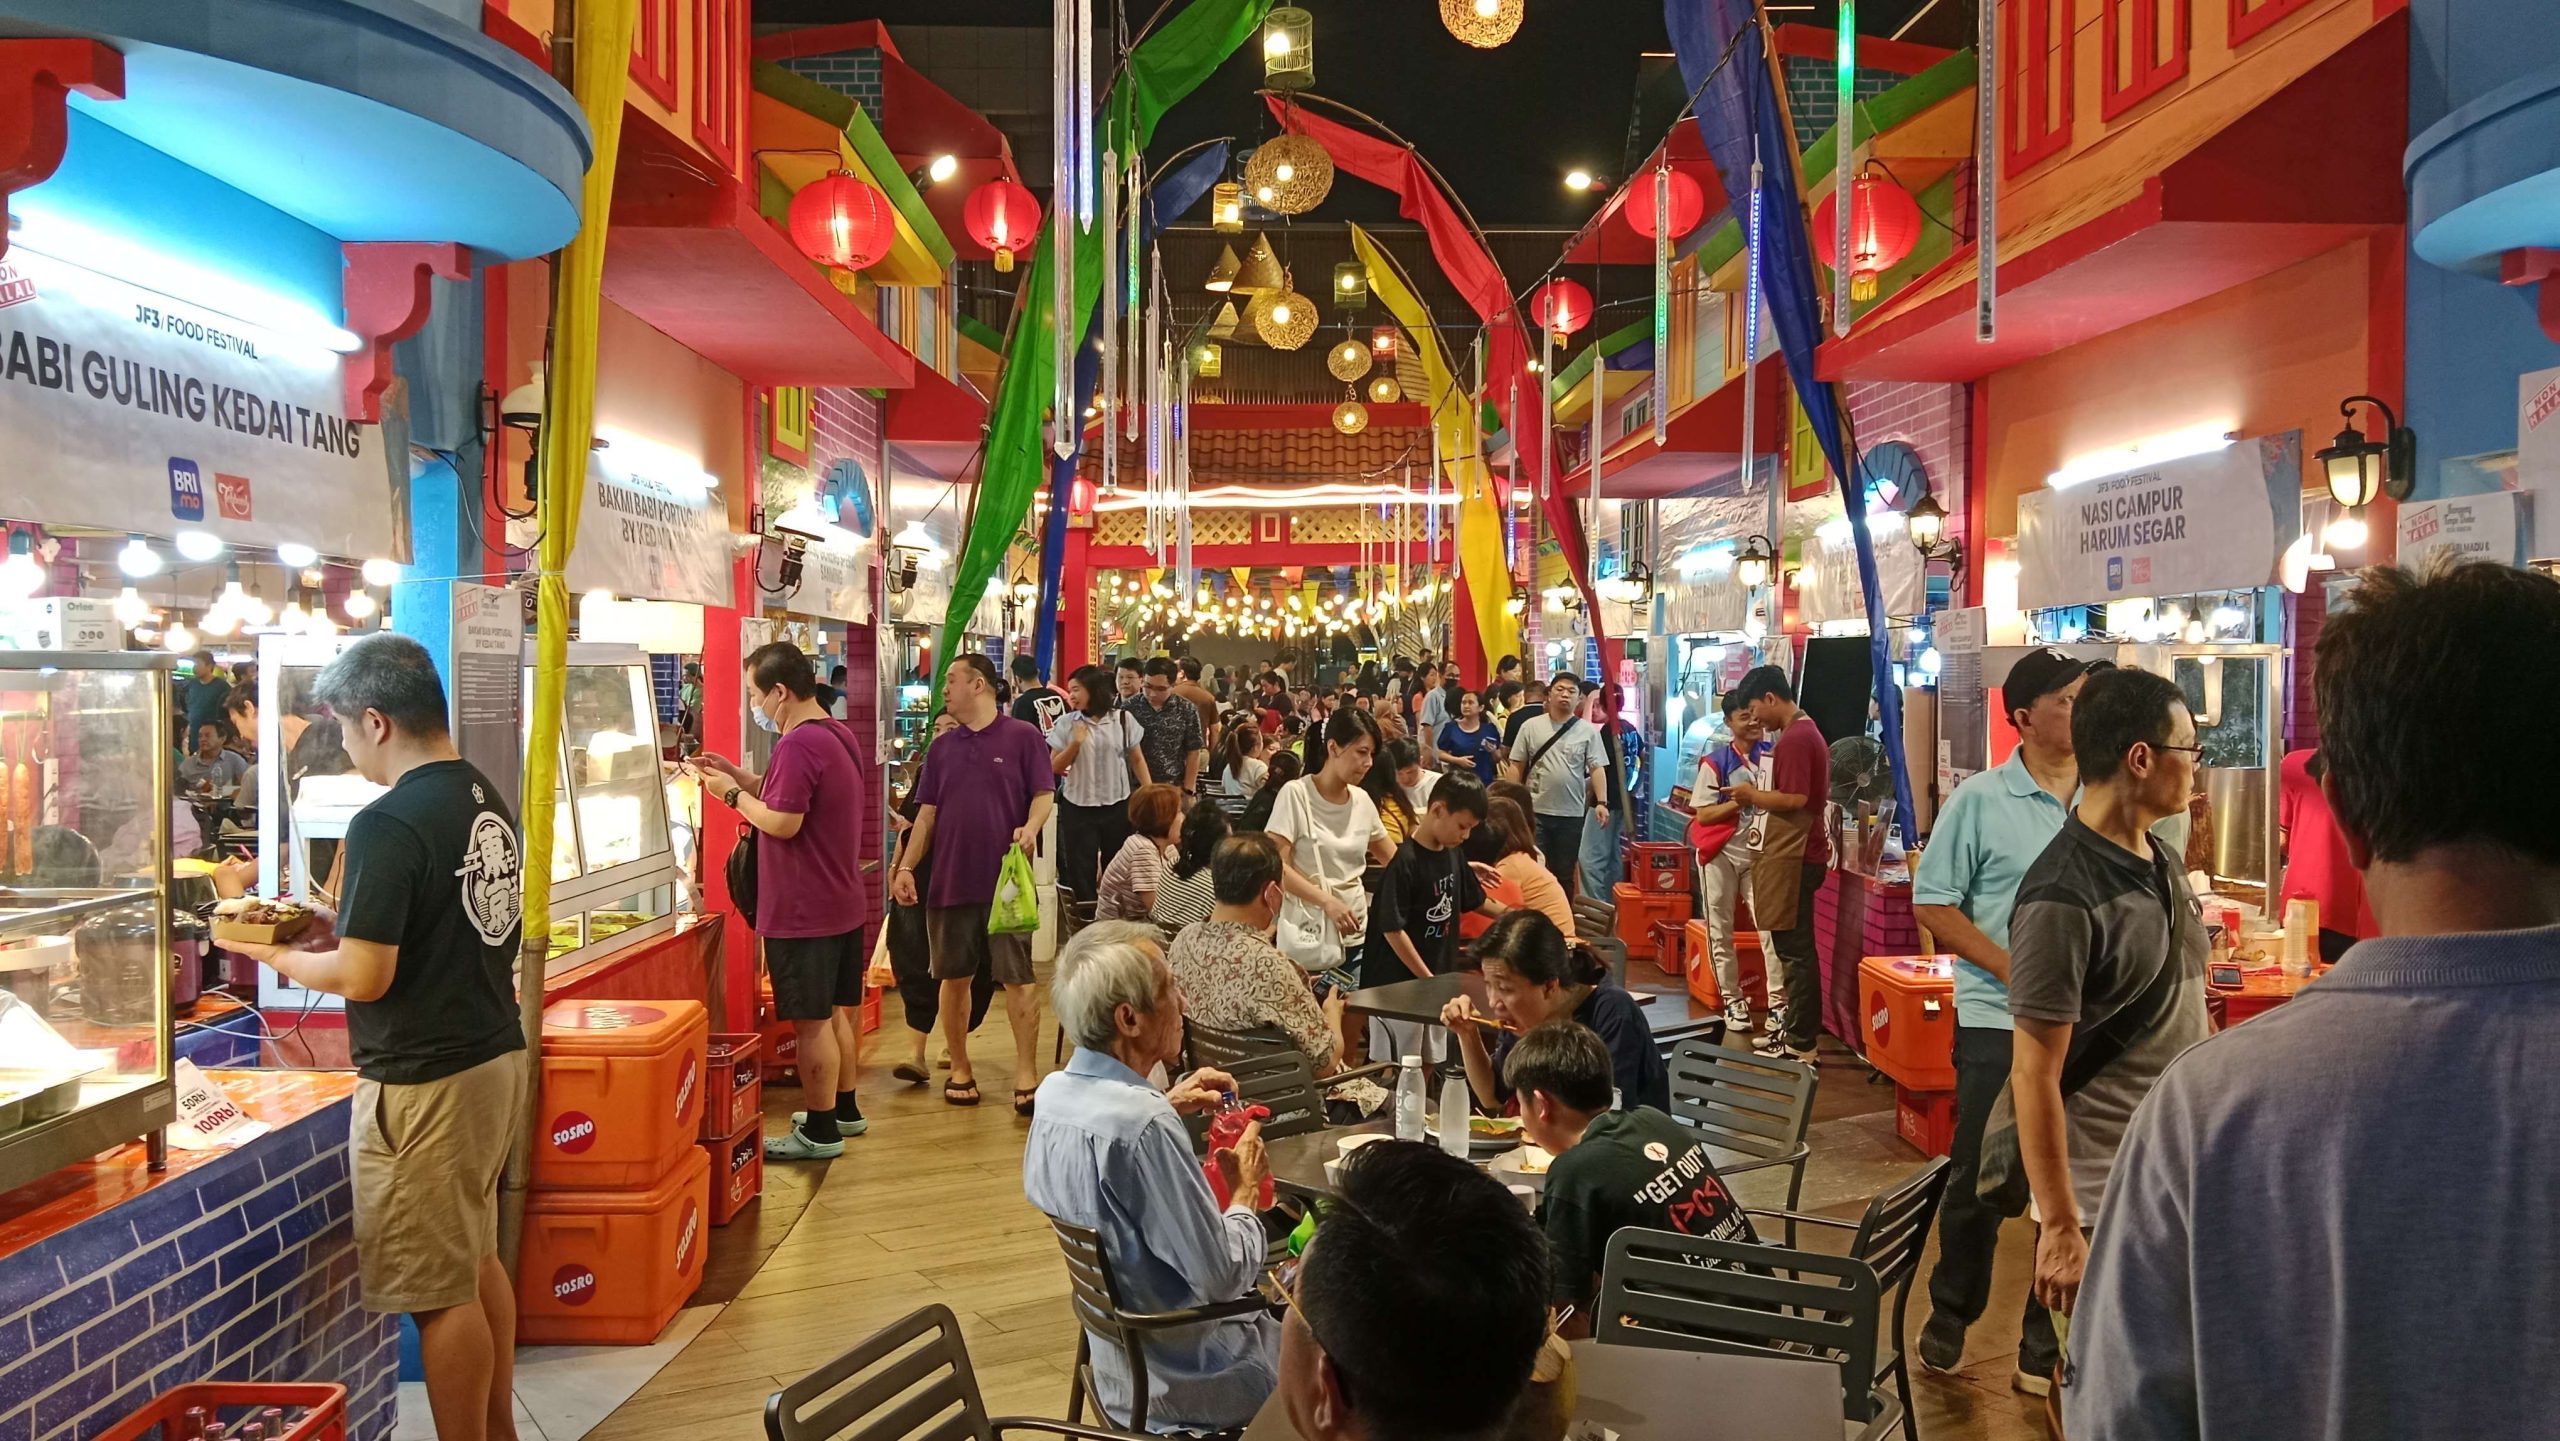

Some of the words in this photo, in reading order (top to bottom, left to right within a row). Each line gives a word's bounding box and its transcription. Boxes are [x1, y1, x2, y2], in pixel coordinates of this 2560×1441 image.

[0, 279, 35, 303] LAL
[167, 314, 204, 341] FOOD
[206, 327, 258, 360] FESTIVAL
[0, 330, 74, 394] ABI
[82, 350, 207, 422] GULING
[212, 383, 293, 444] KEDAI
[296, 406, 361, 459] TANG
[2534, 382, 2557, 409] NON
[173, 469, 198, 494] BRI
[2130, 470, 2162, 487] FESTIVAL
[598, 482, 634, 514] BAKMI
[634, 491, 657, 522] BABI
[2081, 499, 2113, 527] NASI
[2116, 485, 2183, 520] CAMPUR
[621, 517, 636, 544] BY
[2080, 523, 2130, 555] HARUM
[2133, 514, 2186, 546] SEGAR
[1872, 1007, 1889, 1032] SOSRO
[776, 1039, 797, 1055] SOSR
[182, 1089, 209, 1110] 50Rb!
[675, 1060, 696, 1118] SOSRO
[194, 1102, 239, 1134] 100Rb!
[553, 1120, 594, 1146] SOSRO
[1633, 1167, 1684, 1205] "GET
[1676, 1144, 1705, 1180] OUT"
[676, 1207, 697, 1270] SOSRO
[554, 1273, 594, 1297] SOSRO
